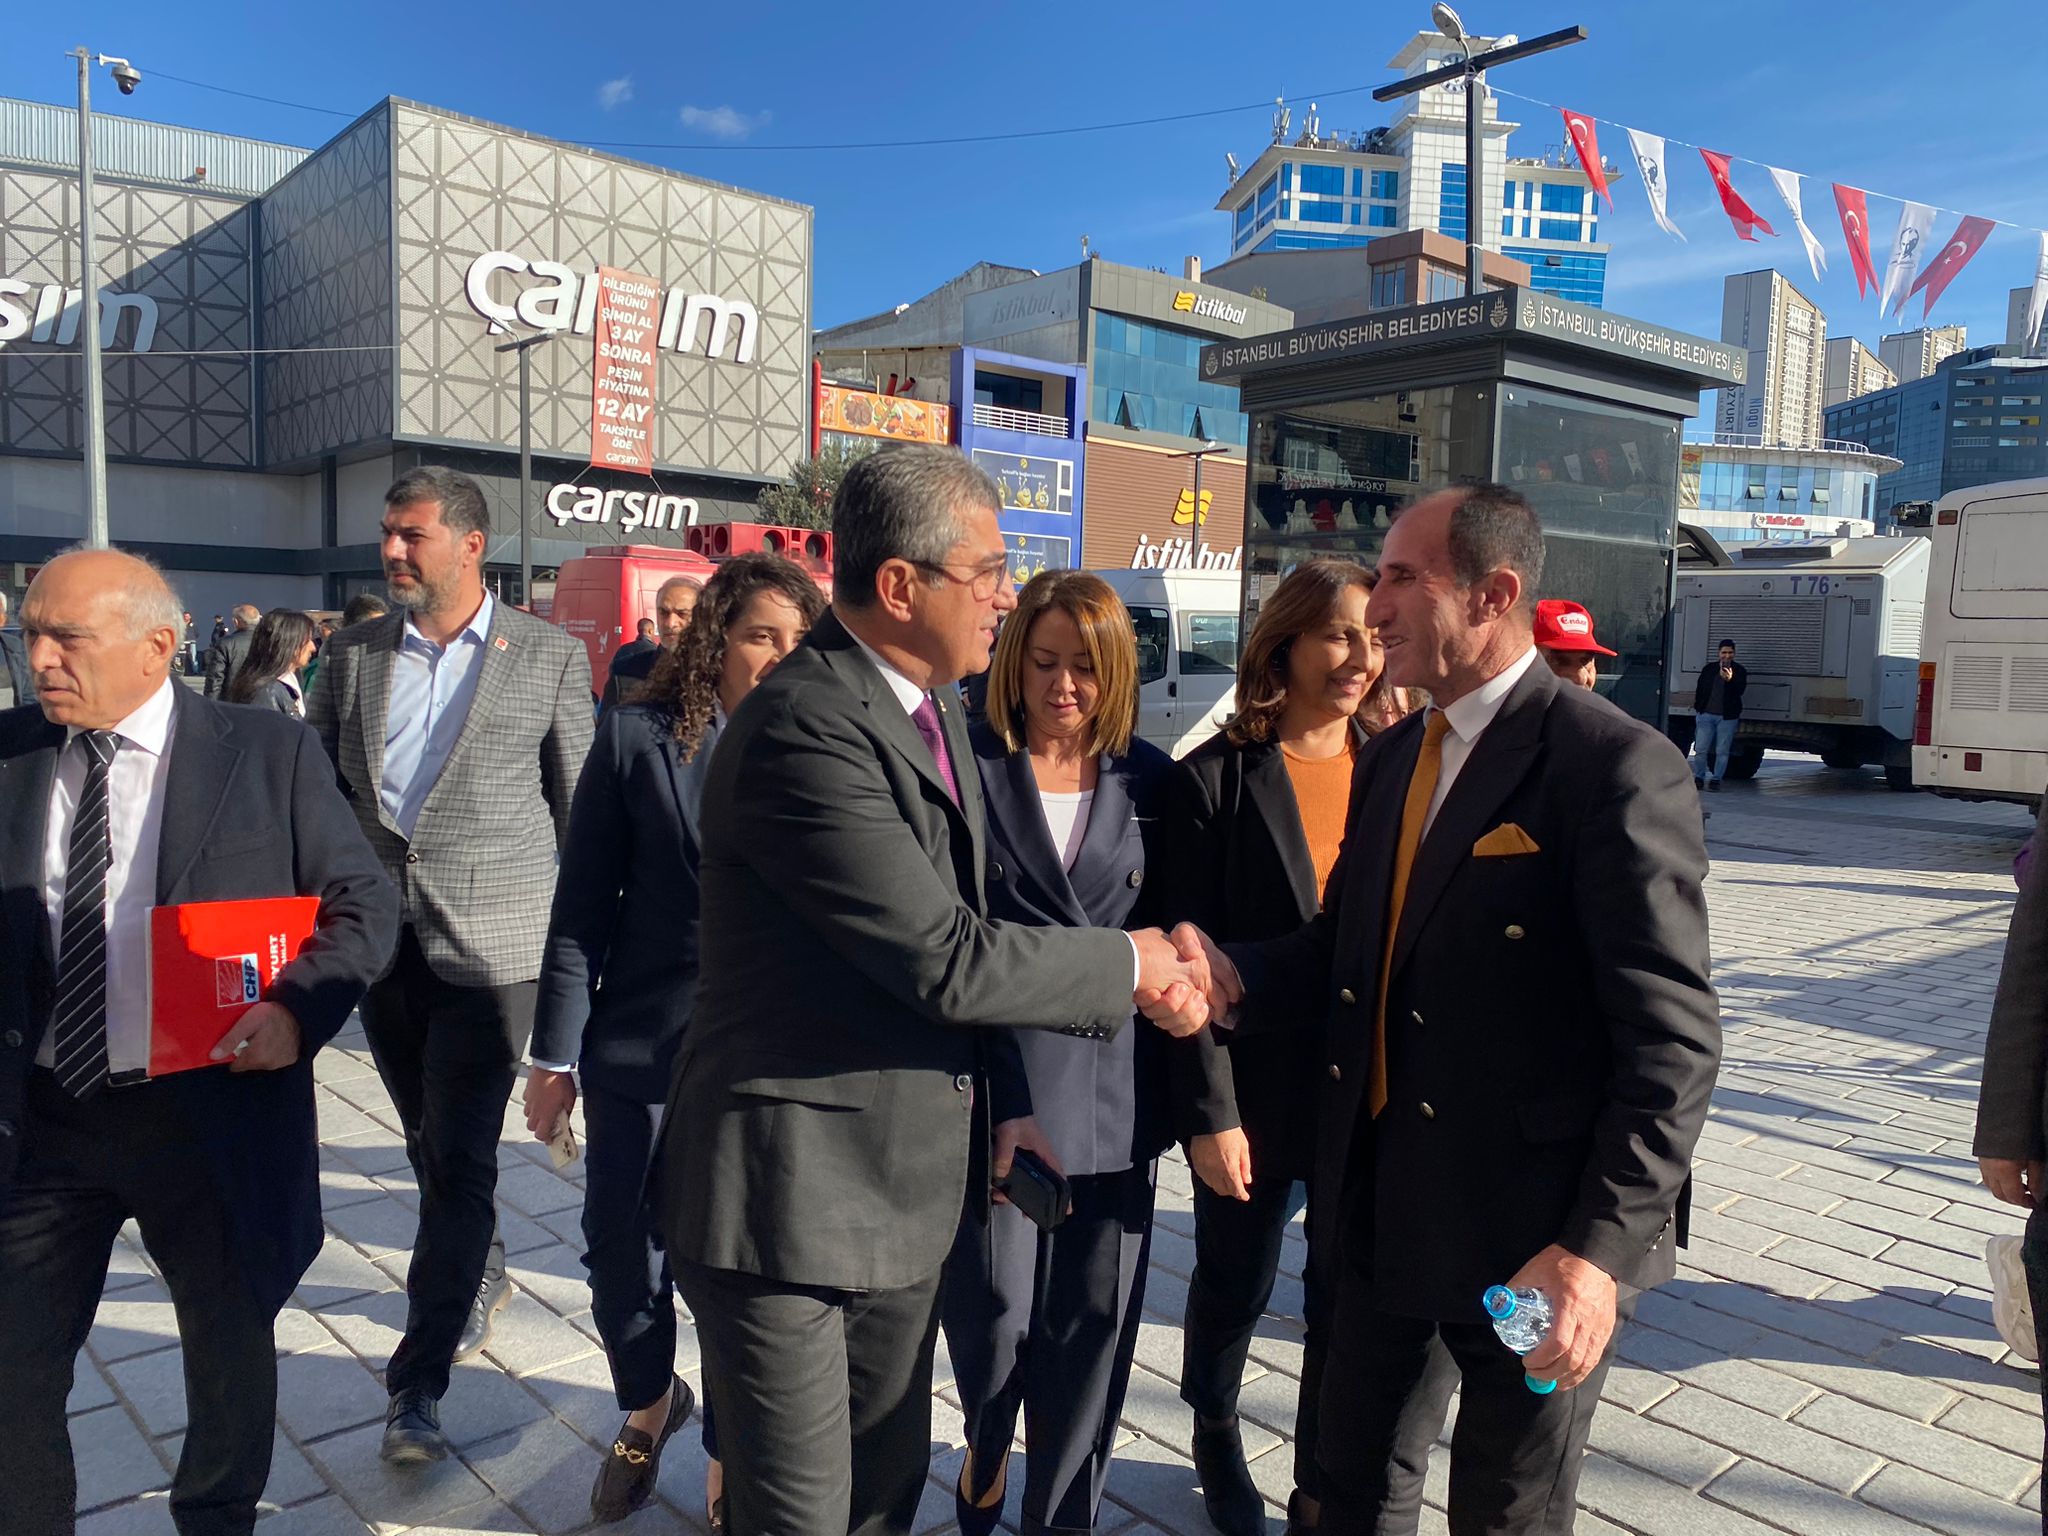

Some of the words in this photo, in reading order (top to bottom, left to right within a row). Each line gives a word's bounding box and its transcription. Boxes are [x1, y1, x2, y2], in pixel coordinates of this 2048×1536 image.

[602, 276, 656, 299] DİLEDİĞİN
[465, 250, 759, 363] çarım
[609, 291, 648, 310] ÜRÜNÜ
[1194, 294, 1247, 325] istikbal
[601, 306, 637, 325] ŞİMDİ
[637, 316, 653, 329] AL
[610, 325, 621, 340] 3
[622, 328, 644, 344] AY
[1222, 339, 1286, 368] İSTANBUL
[1288, 319, 1384, 355] BÜYÜKŞEHİR
[1387, 300, 1484, 339] BELEDİYESİ
[1540, 300, 1598, 338] İSTANBUL
[1600, 319, 1671, 356] BÜYÜKŞEHİR
[1673, 340, 1732, 372] BELEDİYESİ
[599, 342, 652, 366] SONRA
[607, 365, 643, 382] PEŞİN
[598, 377, 650, 398] FİYATINA
[597, 397, 619, 418] 12
[621, 402, 650, 423] AY
[599, 422, 647, 440] TAKSİTLE
[611, 436, 633, 450] ÖDE
[1790, 576, 1802, 595] T
[1808, 576, 1830, 595] 76
[269, 934, 279, 980] YURT
[244, 958, 257, 999] CHP
